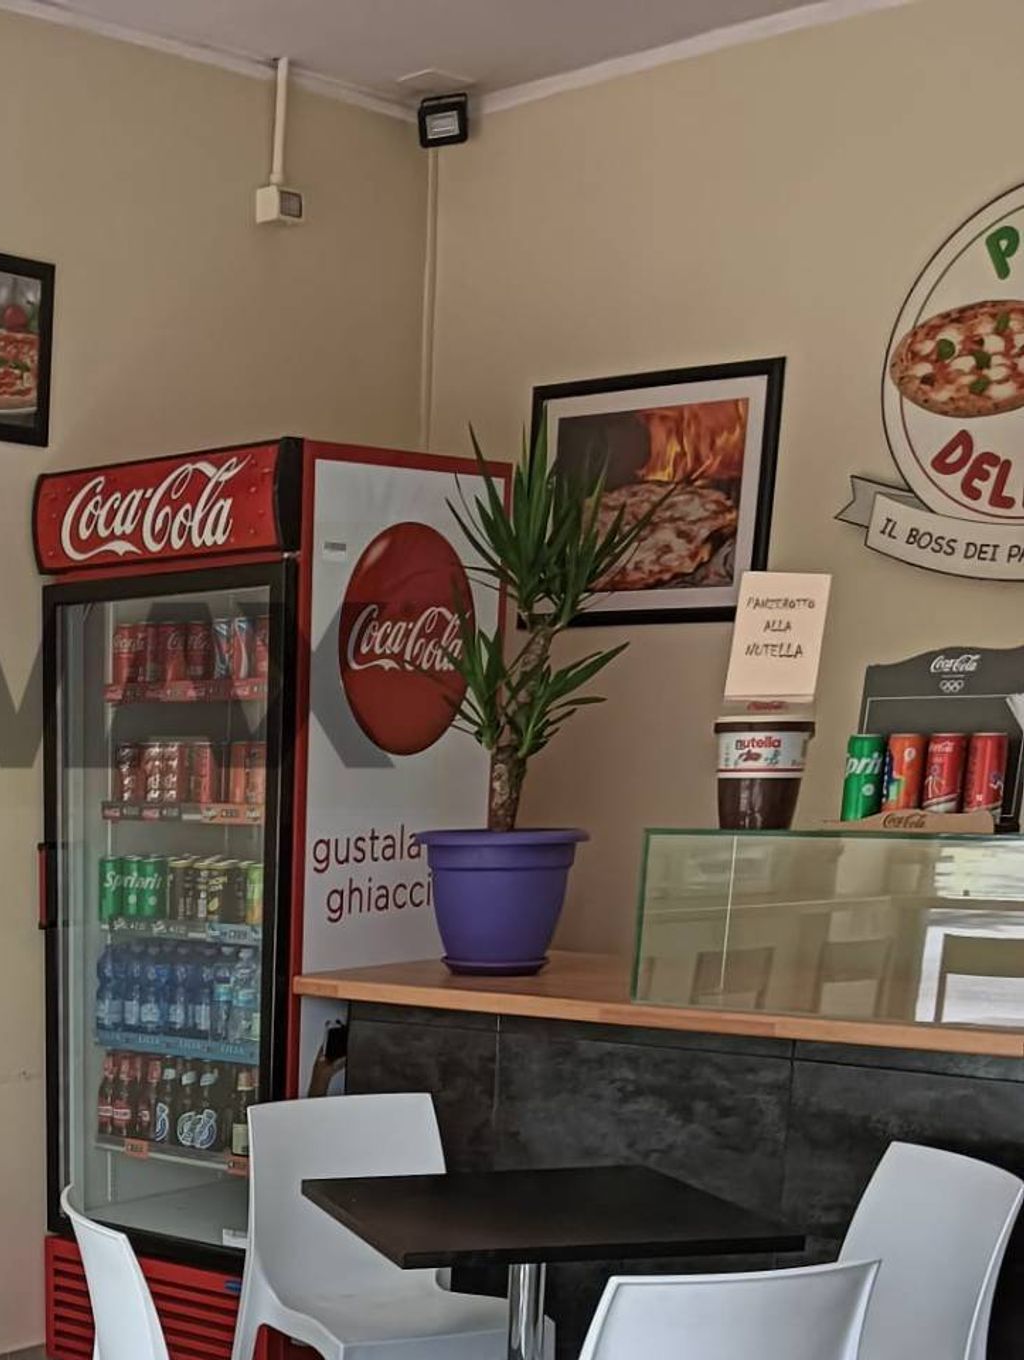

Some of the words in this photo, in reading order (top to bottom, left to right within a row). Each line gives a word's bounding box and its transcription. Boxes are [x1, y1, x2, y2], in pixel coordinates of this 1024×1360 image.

[985, 225, 1020, 281] P
[930, 429, 1024, 509] DEL
[60, 454, 252, 561] Coca-Cola
[879, 517, 898, 540] IL
[905, 527, 958, 556] BOSS
[963, 541, 1000, 562] DEI
[763, 619, 793, 633] ALLA
[744, 643, 804, 659] NUTELLA
[735, 735, 782, 750] nutella
[845, 751, 884, 775] prit
[313, 823, 421, 873] gustala
[326, 872, 432, 923] ghiacci
